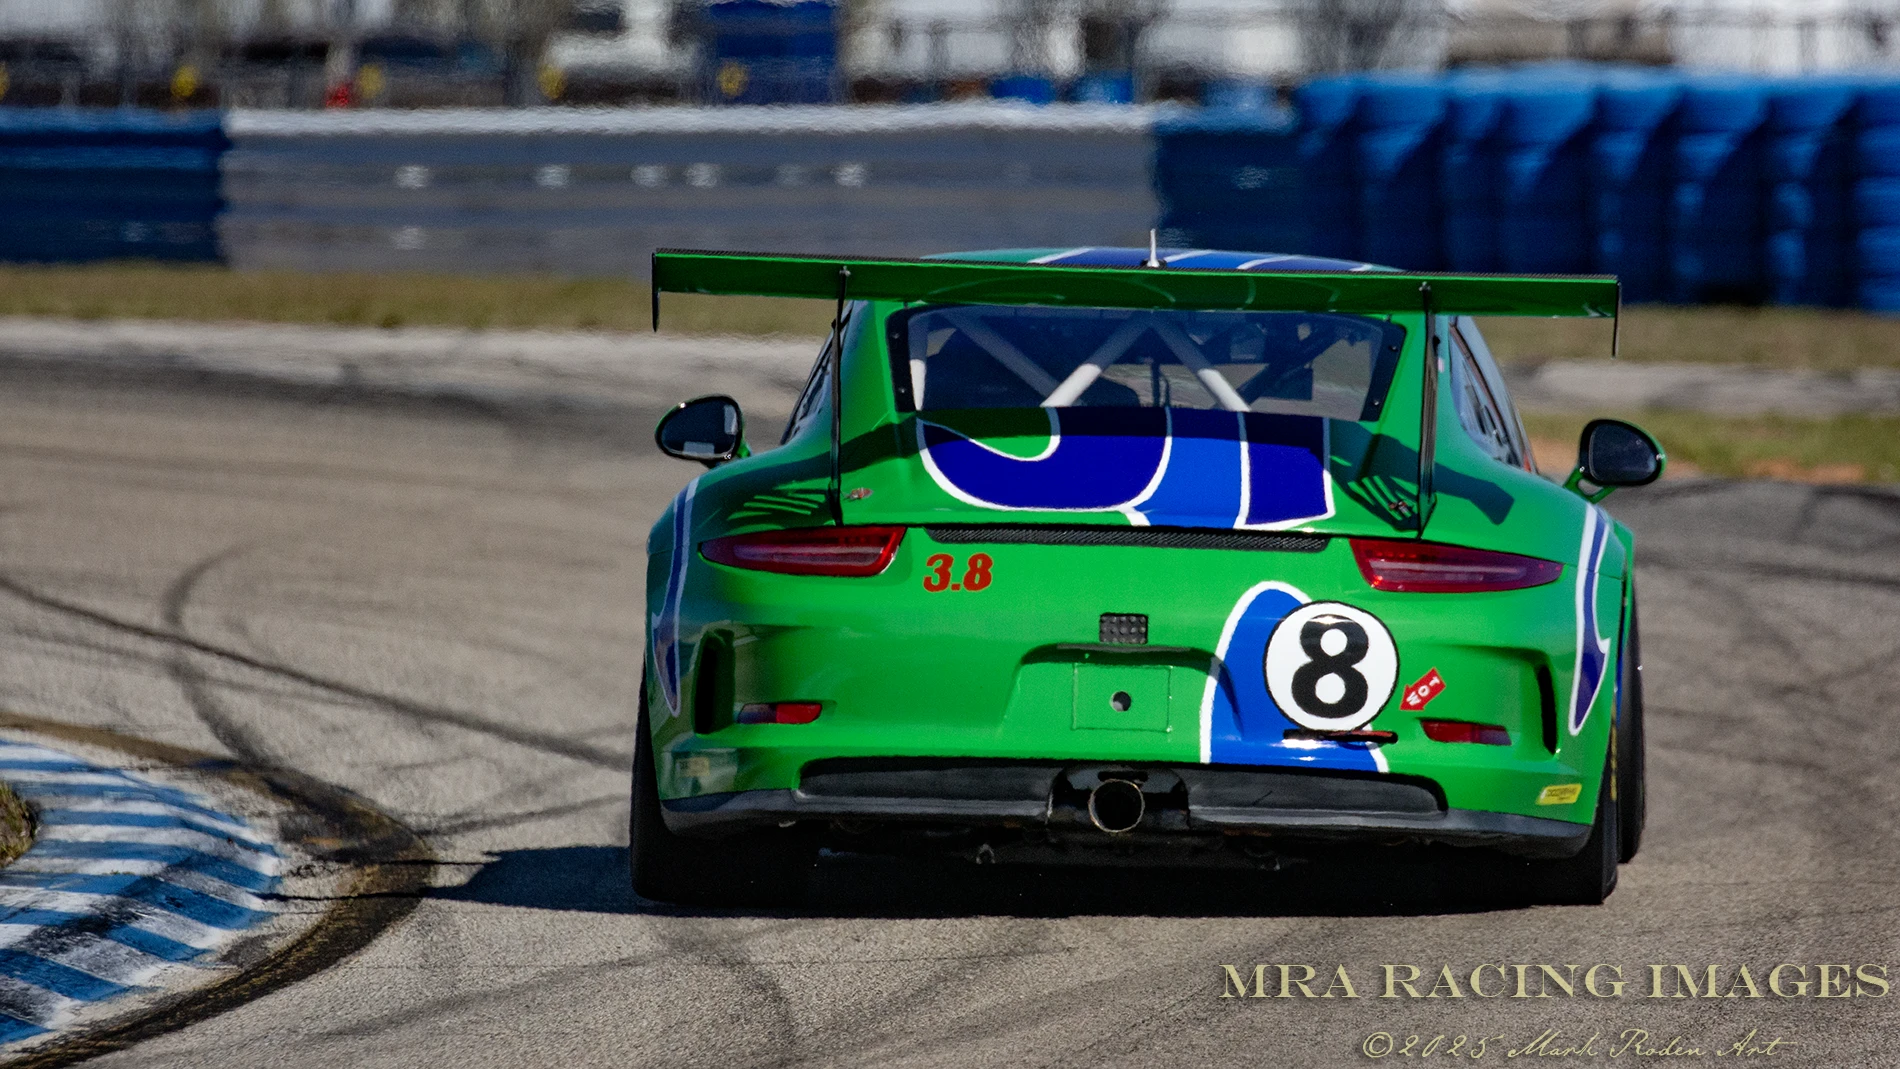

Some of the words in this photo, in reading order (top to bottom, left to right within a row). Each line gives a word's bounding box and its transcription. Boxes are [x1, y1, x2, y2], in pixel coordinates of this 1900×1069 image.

[923, 552, 994, 593] 3.8
[1290, 614, 1370, 719] 8
[1406, 676, 1441, 706] TOW
